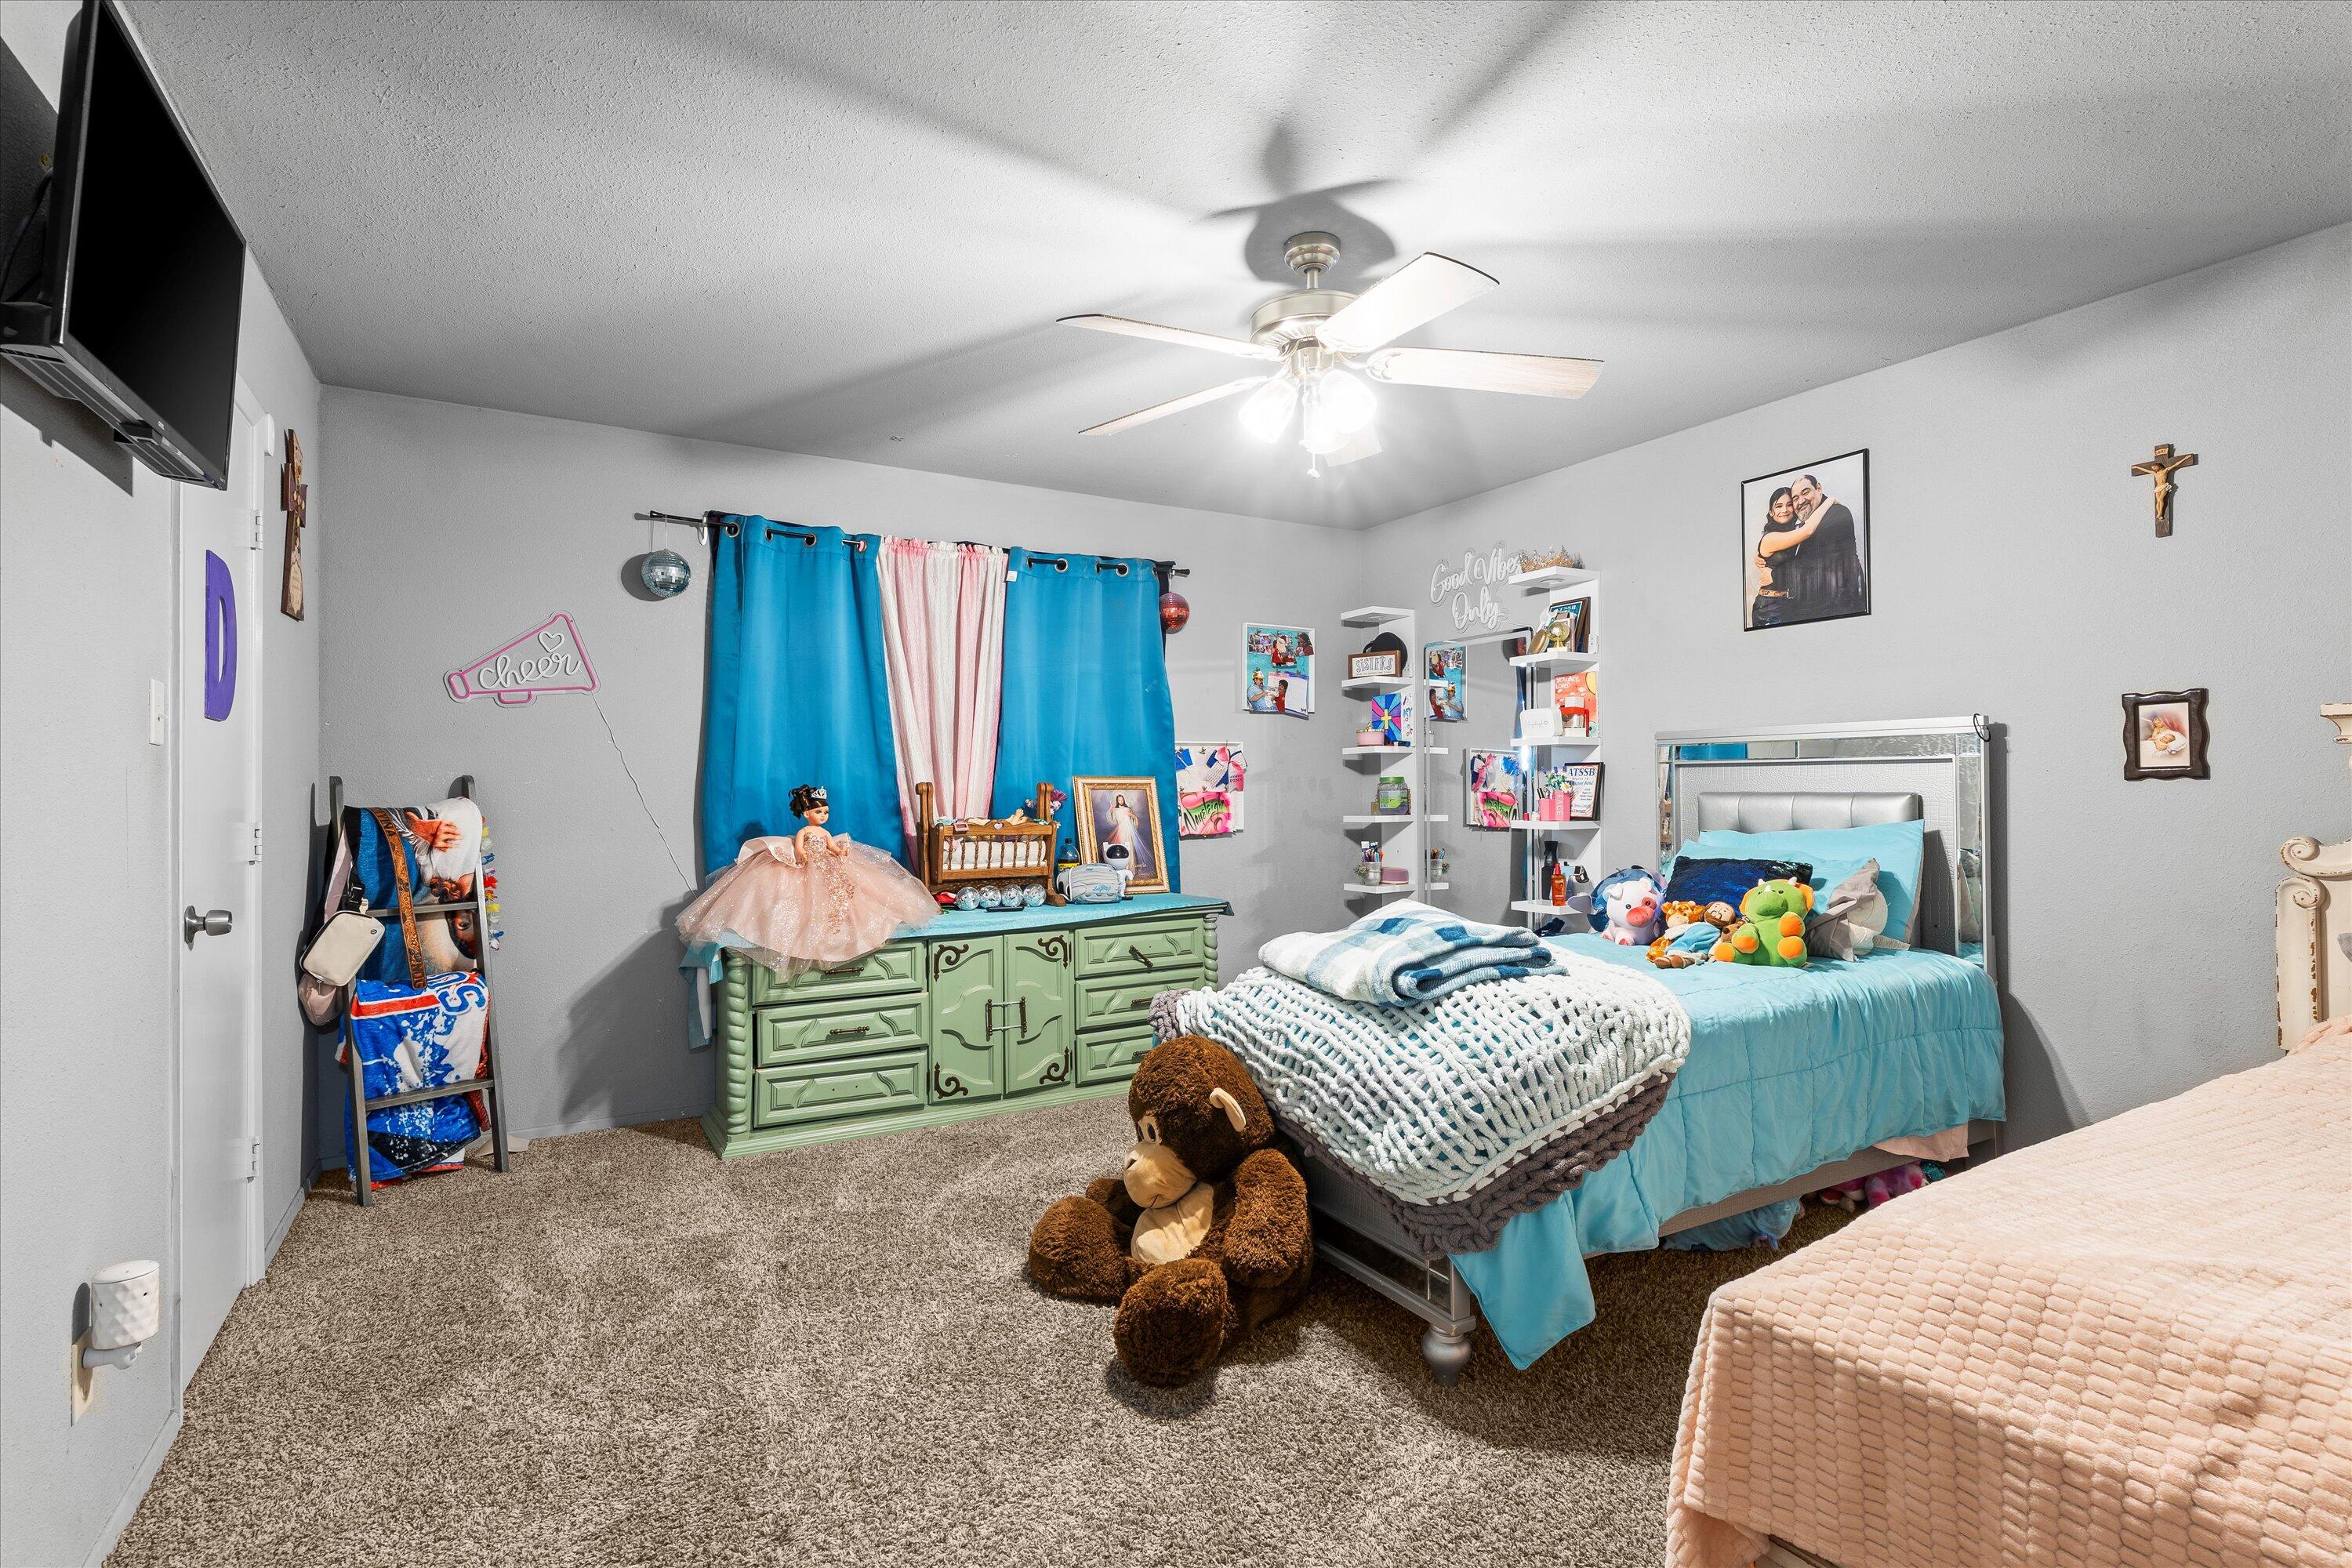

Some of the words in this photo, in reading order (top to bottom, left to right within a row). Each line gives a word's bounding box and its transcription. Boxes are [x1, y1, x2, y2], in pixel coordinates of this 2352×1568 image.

[1431, 551, 1475, 603] Good
[1452, 586, 1504, 630] Only
[478, 652, 581, 689] cheer
